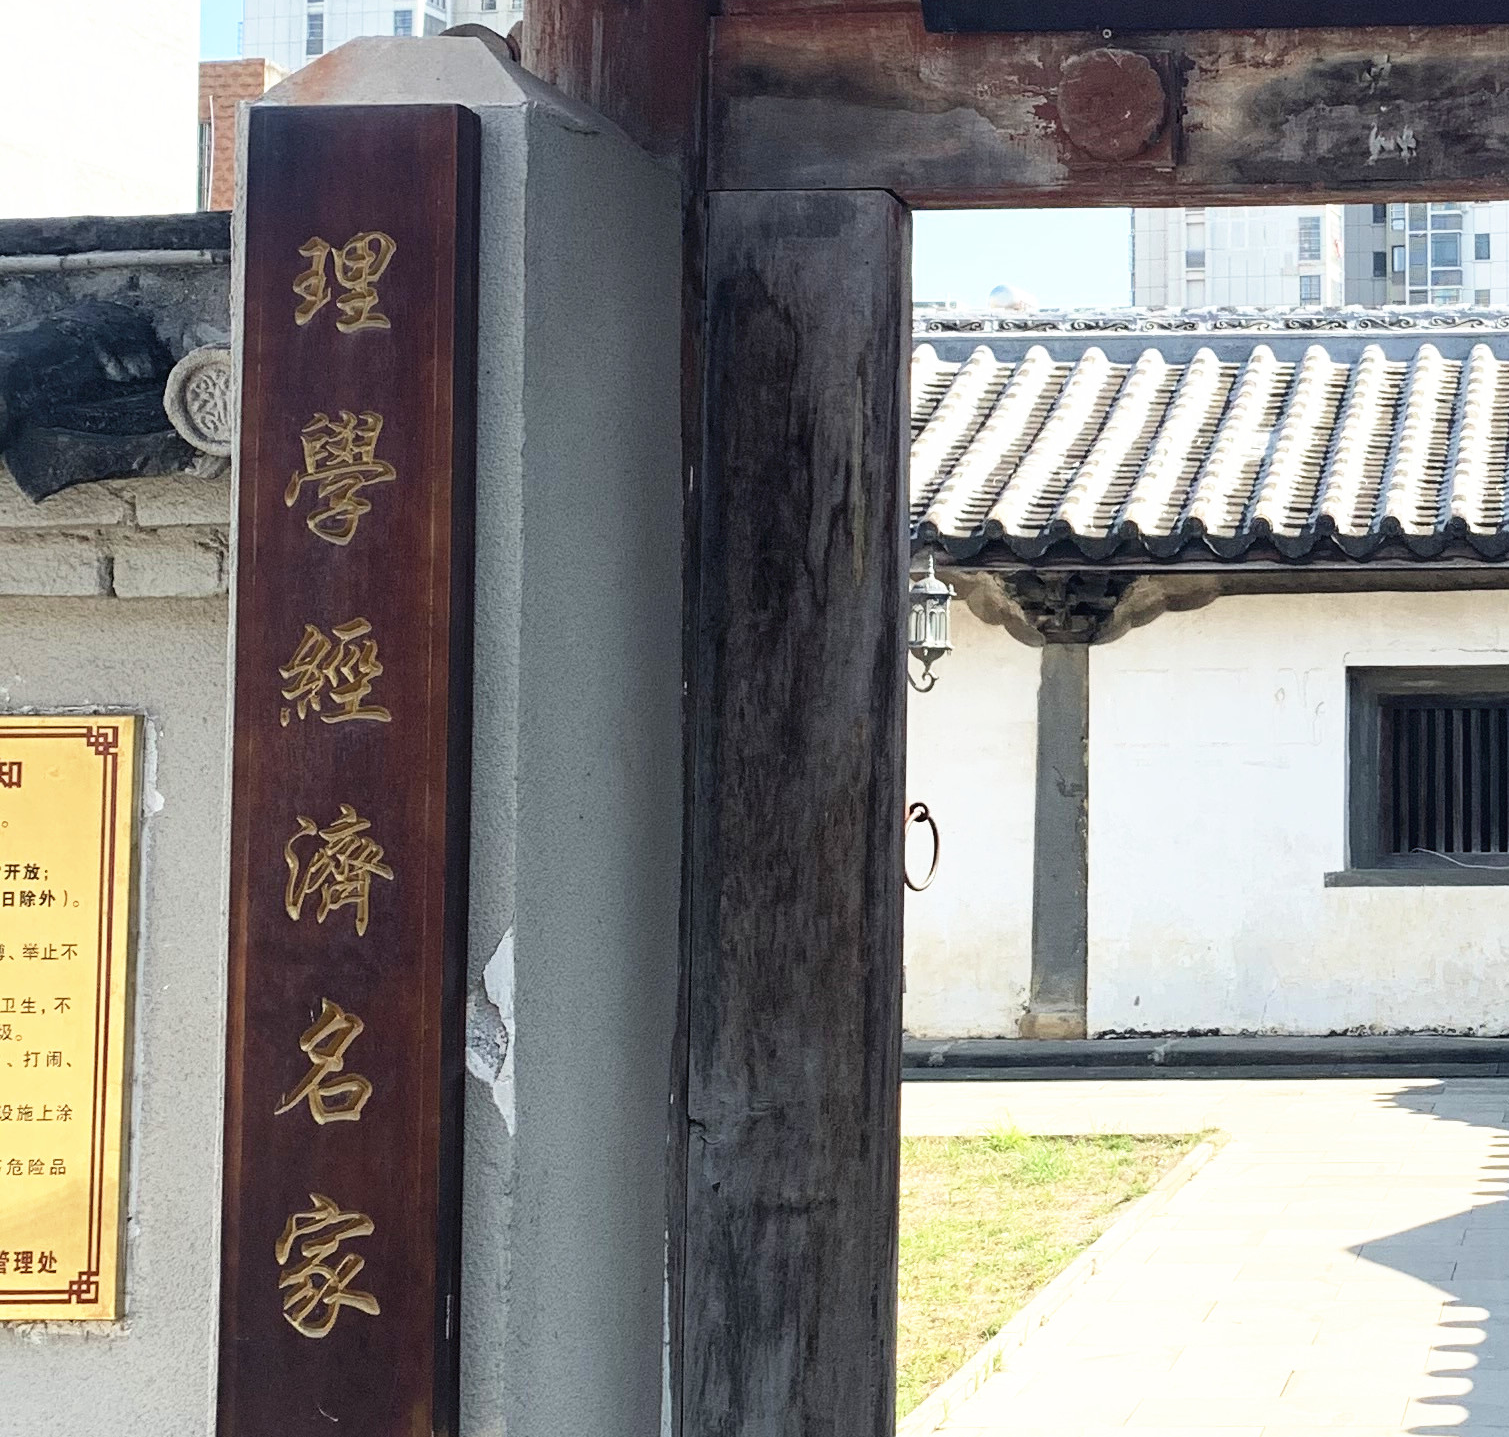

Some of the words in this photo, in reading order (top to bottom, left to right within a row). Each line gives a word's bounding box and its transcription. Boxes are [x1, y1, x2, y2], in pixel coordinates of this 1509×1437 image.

[274, 231, 397, 1339] 理學經濟名家
[0, 1158, 67, 1176] 危险品
